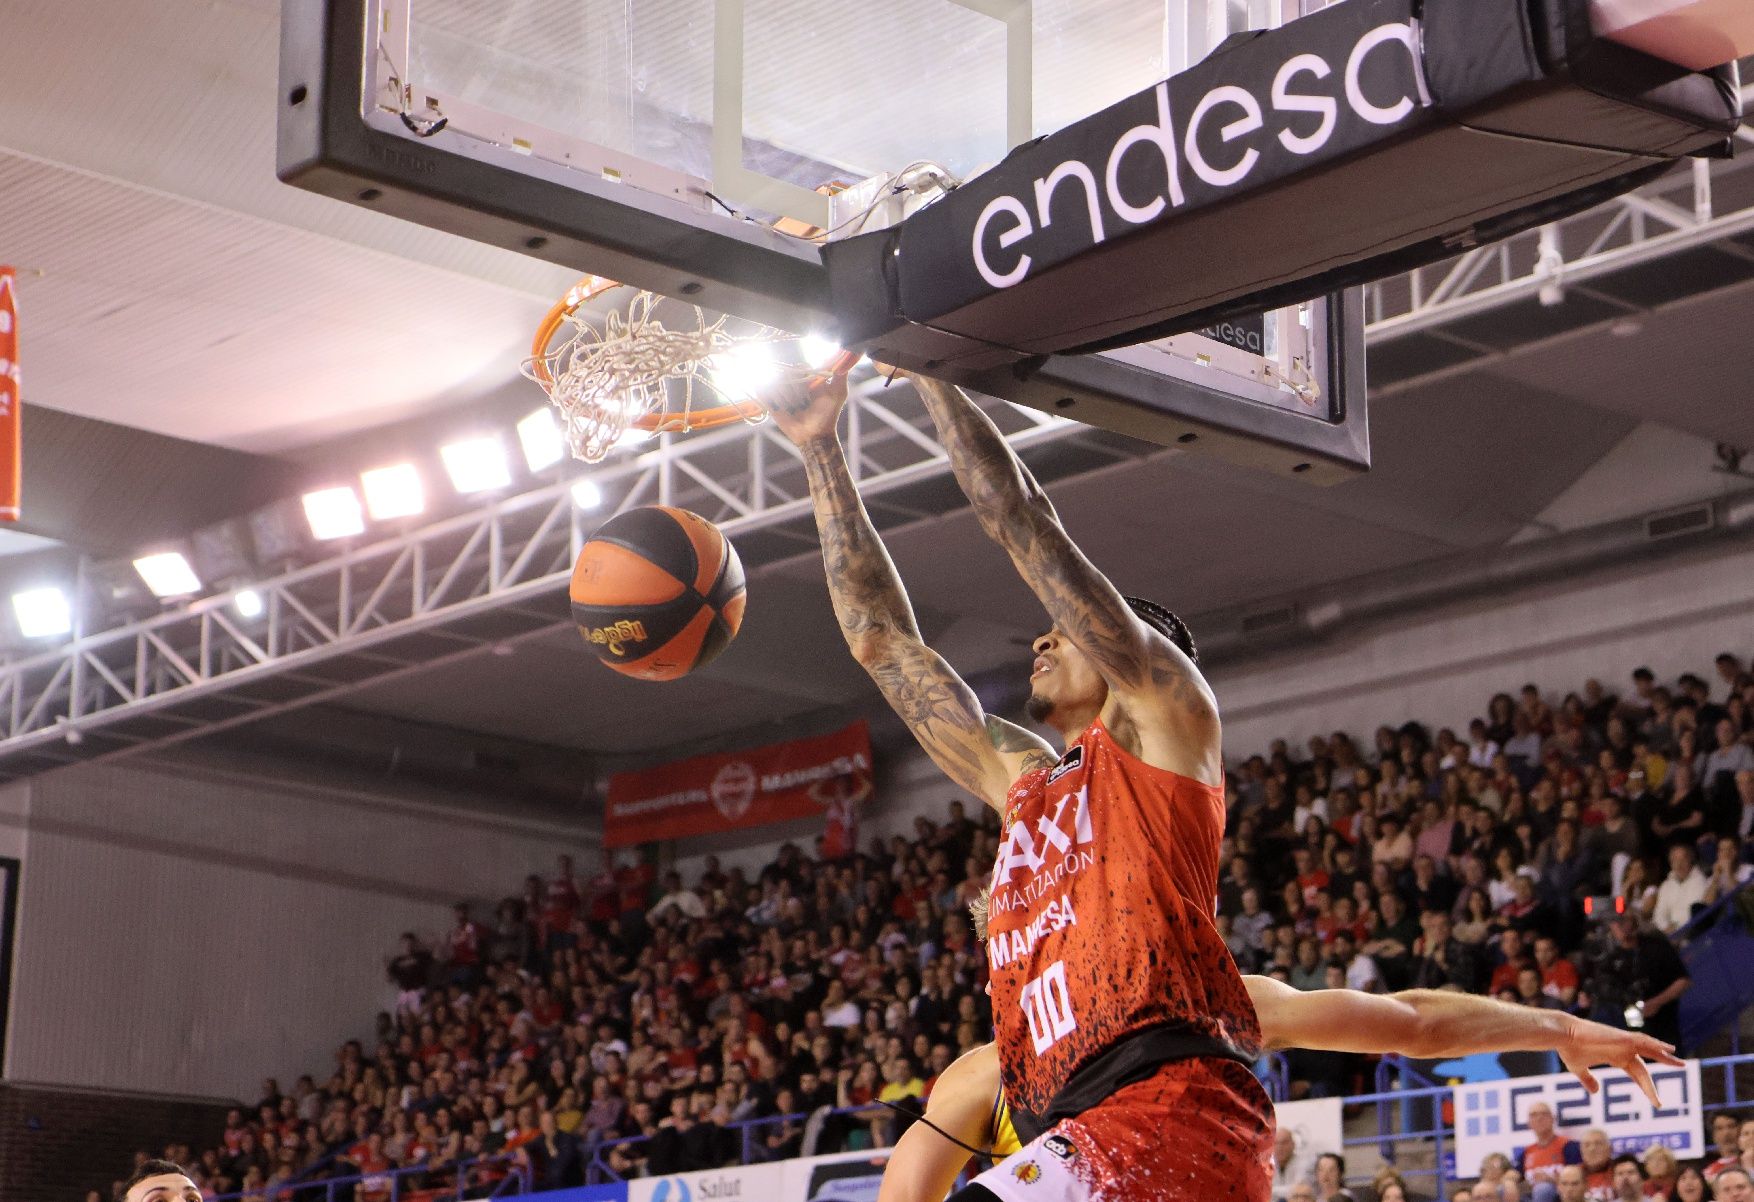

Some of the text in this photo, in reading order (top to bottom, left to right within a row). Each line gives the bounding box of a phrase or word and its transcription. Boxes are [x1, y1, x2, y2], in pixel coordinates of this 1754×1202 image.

[972, 18, 1432, 289] endesa
[1202, 323, 1260, 351] esa
[988, 846, 1095, 921] LIMATIZAÓN
[1020, 960, 1076, 1056] 00
[698, 1176, 742, 1200] Salut
